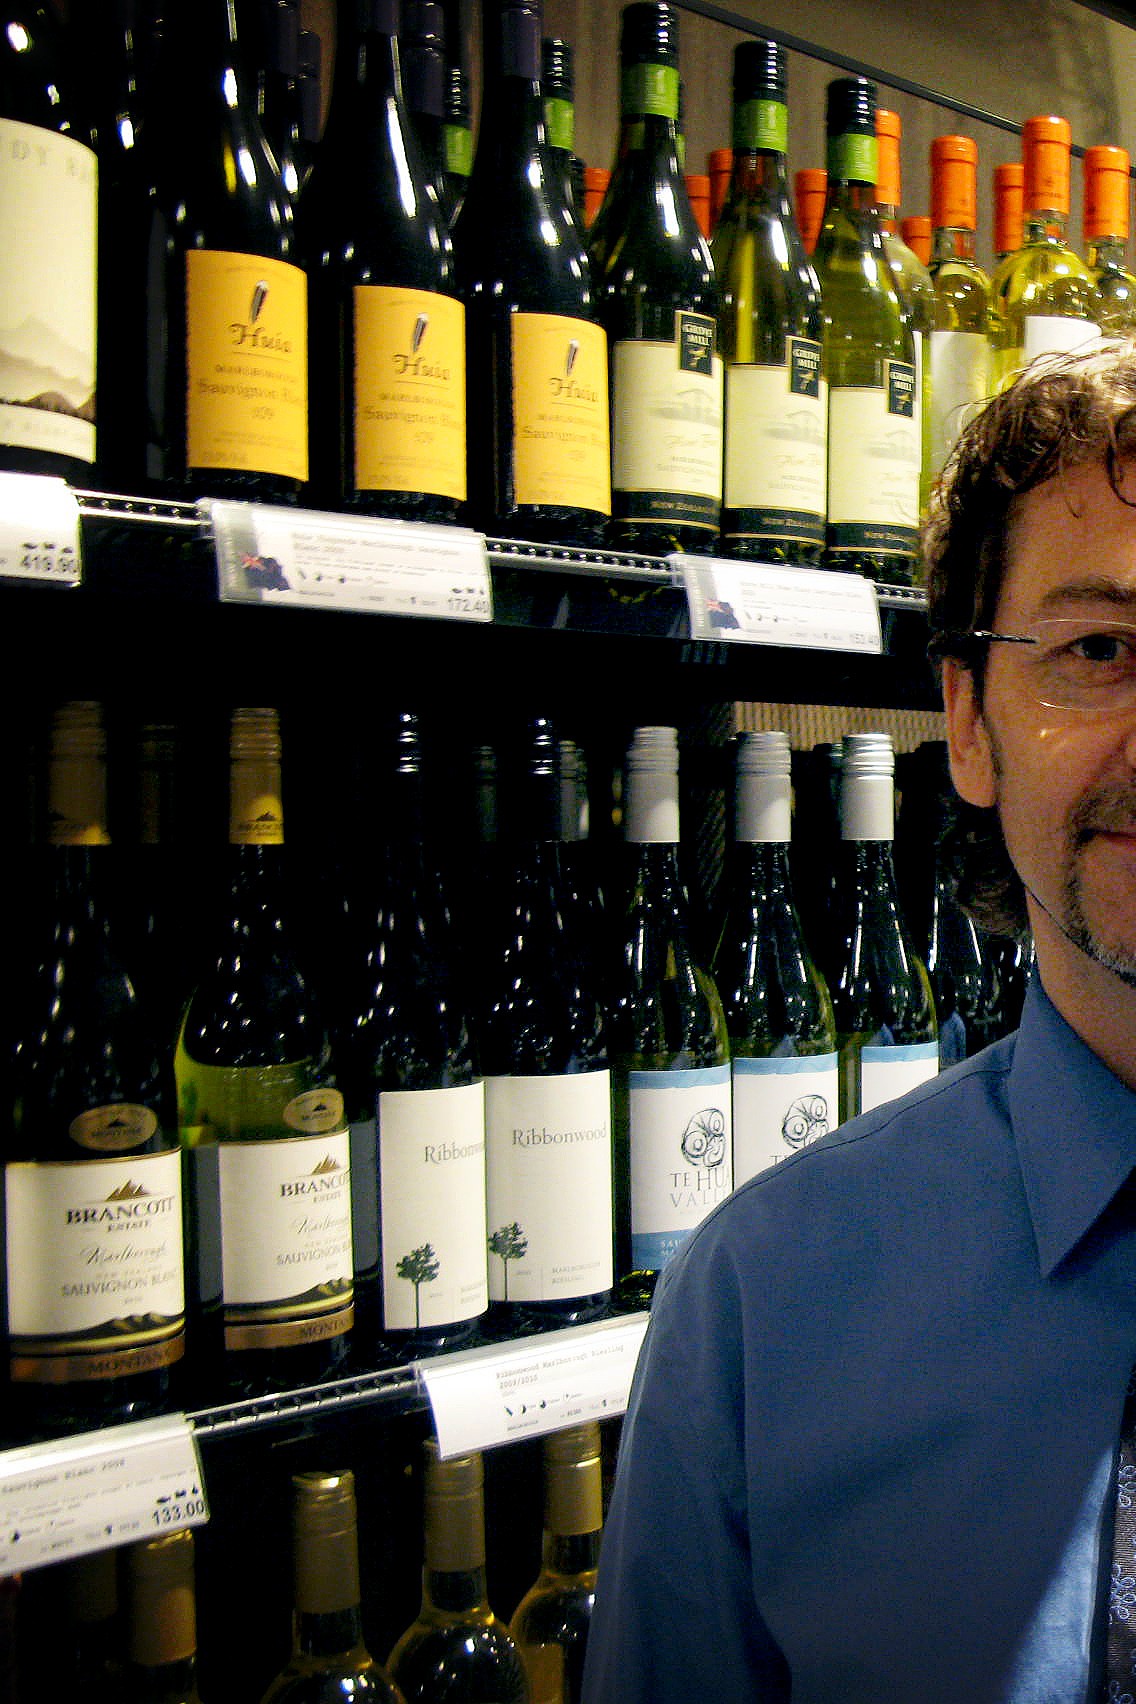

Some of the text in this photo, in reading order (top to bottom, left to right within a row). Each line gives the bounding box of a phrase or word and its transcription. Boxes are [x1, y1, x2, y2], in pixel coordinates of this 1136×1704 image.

[512, 1122, 608, 1148] Ribbonwood
[280, 1174, 350, 1197] BRANCO
[670, 1167, 729, 1191] TE HU
[670, 1188, 727, 1208] VALL
[66, 1196, 175, 1225] BRANCOTT
[61, 1278, 147, 1298] SAUVIGNON
[152, 1499, 206, 1526] 133.00
